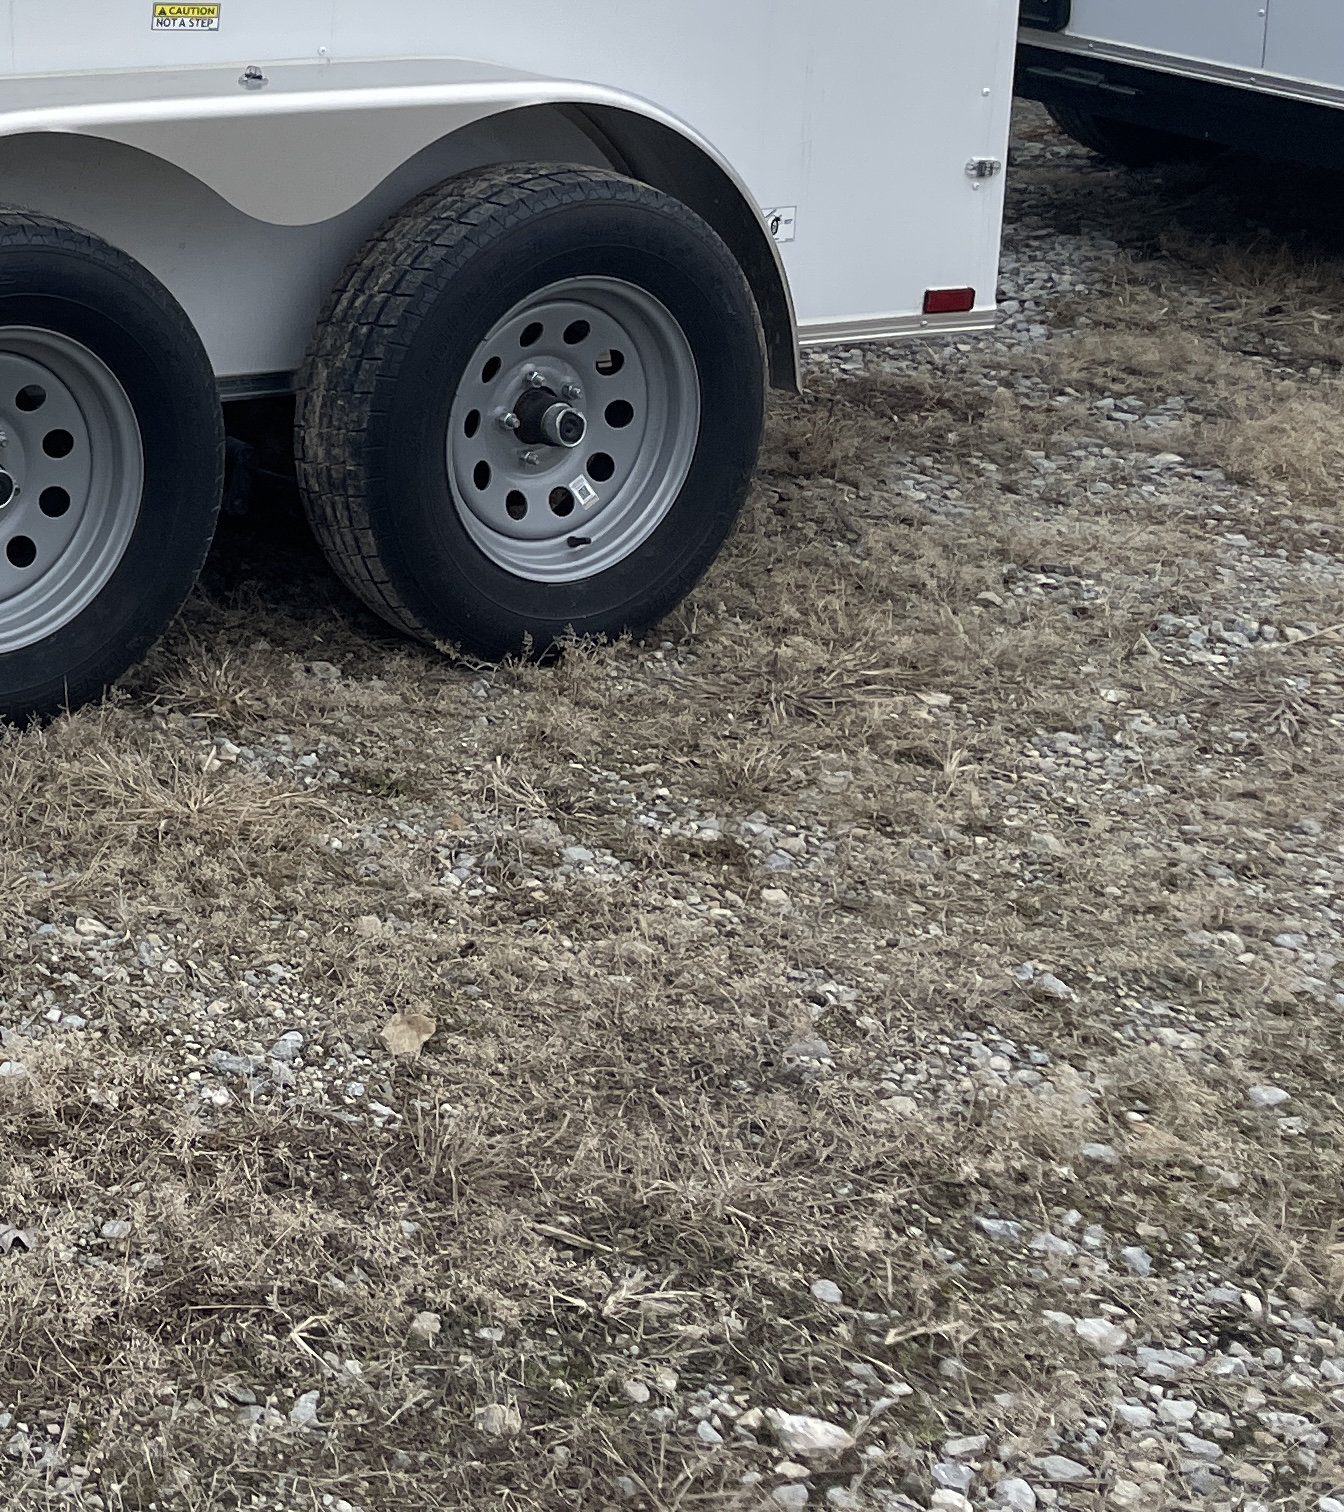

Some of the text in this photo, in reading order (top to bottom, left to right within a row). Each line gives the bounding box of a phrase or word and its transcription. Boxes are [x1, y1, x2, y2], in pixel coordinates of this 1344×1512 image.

[169, 7, 215, 16] CAUTION
[156, 18, 214, 28] NOT A STEP
